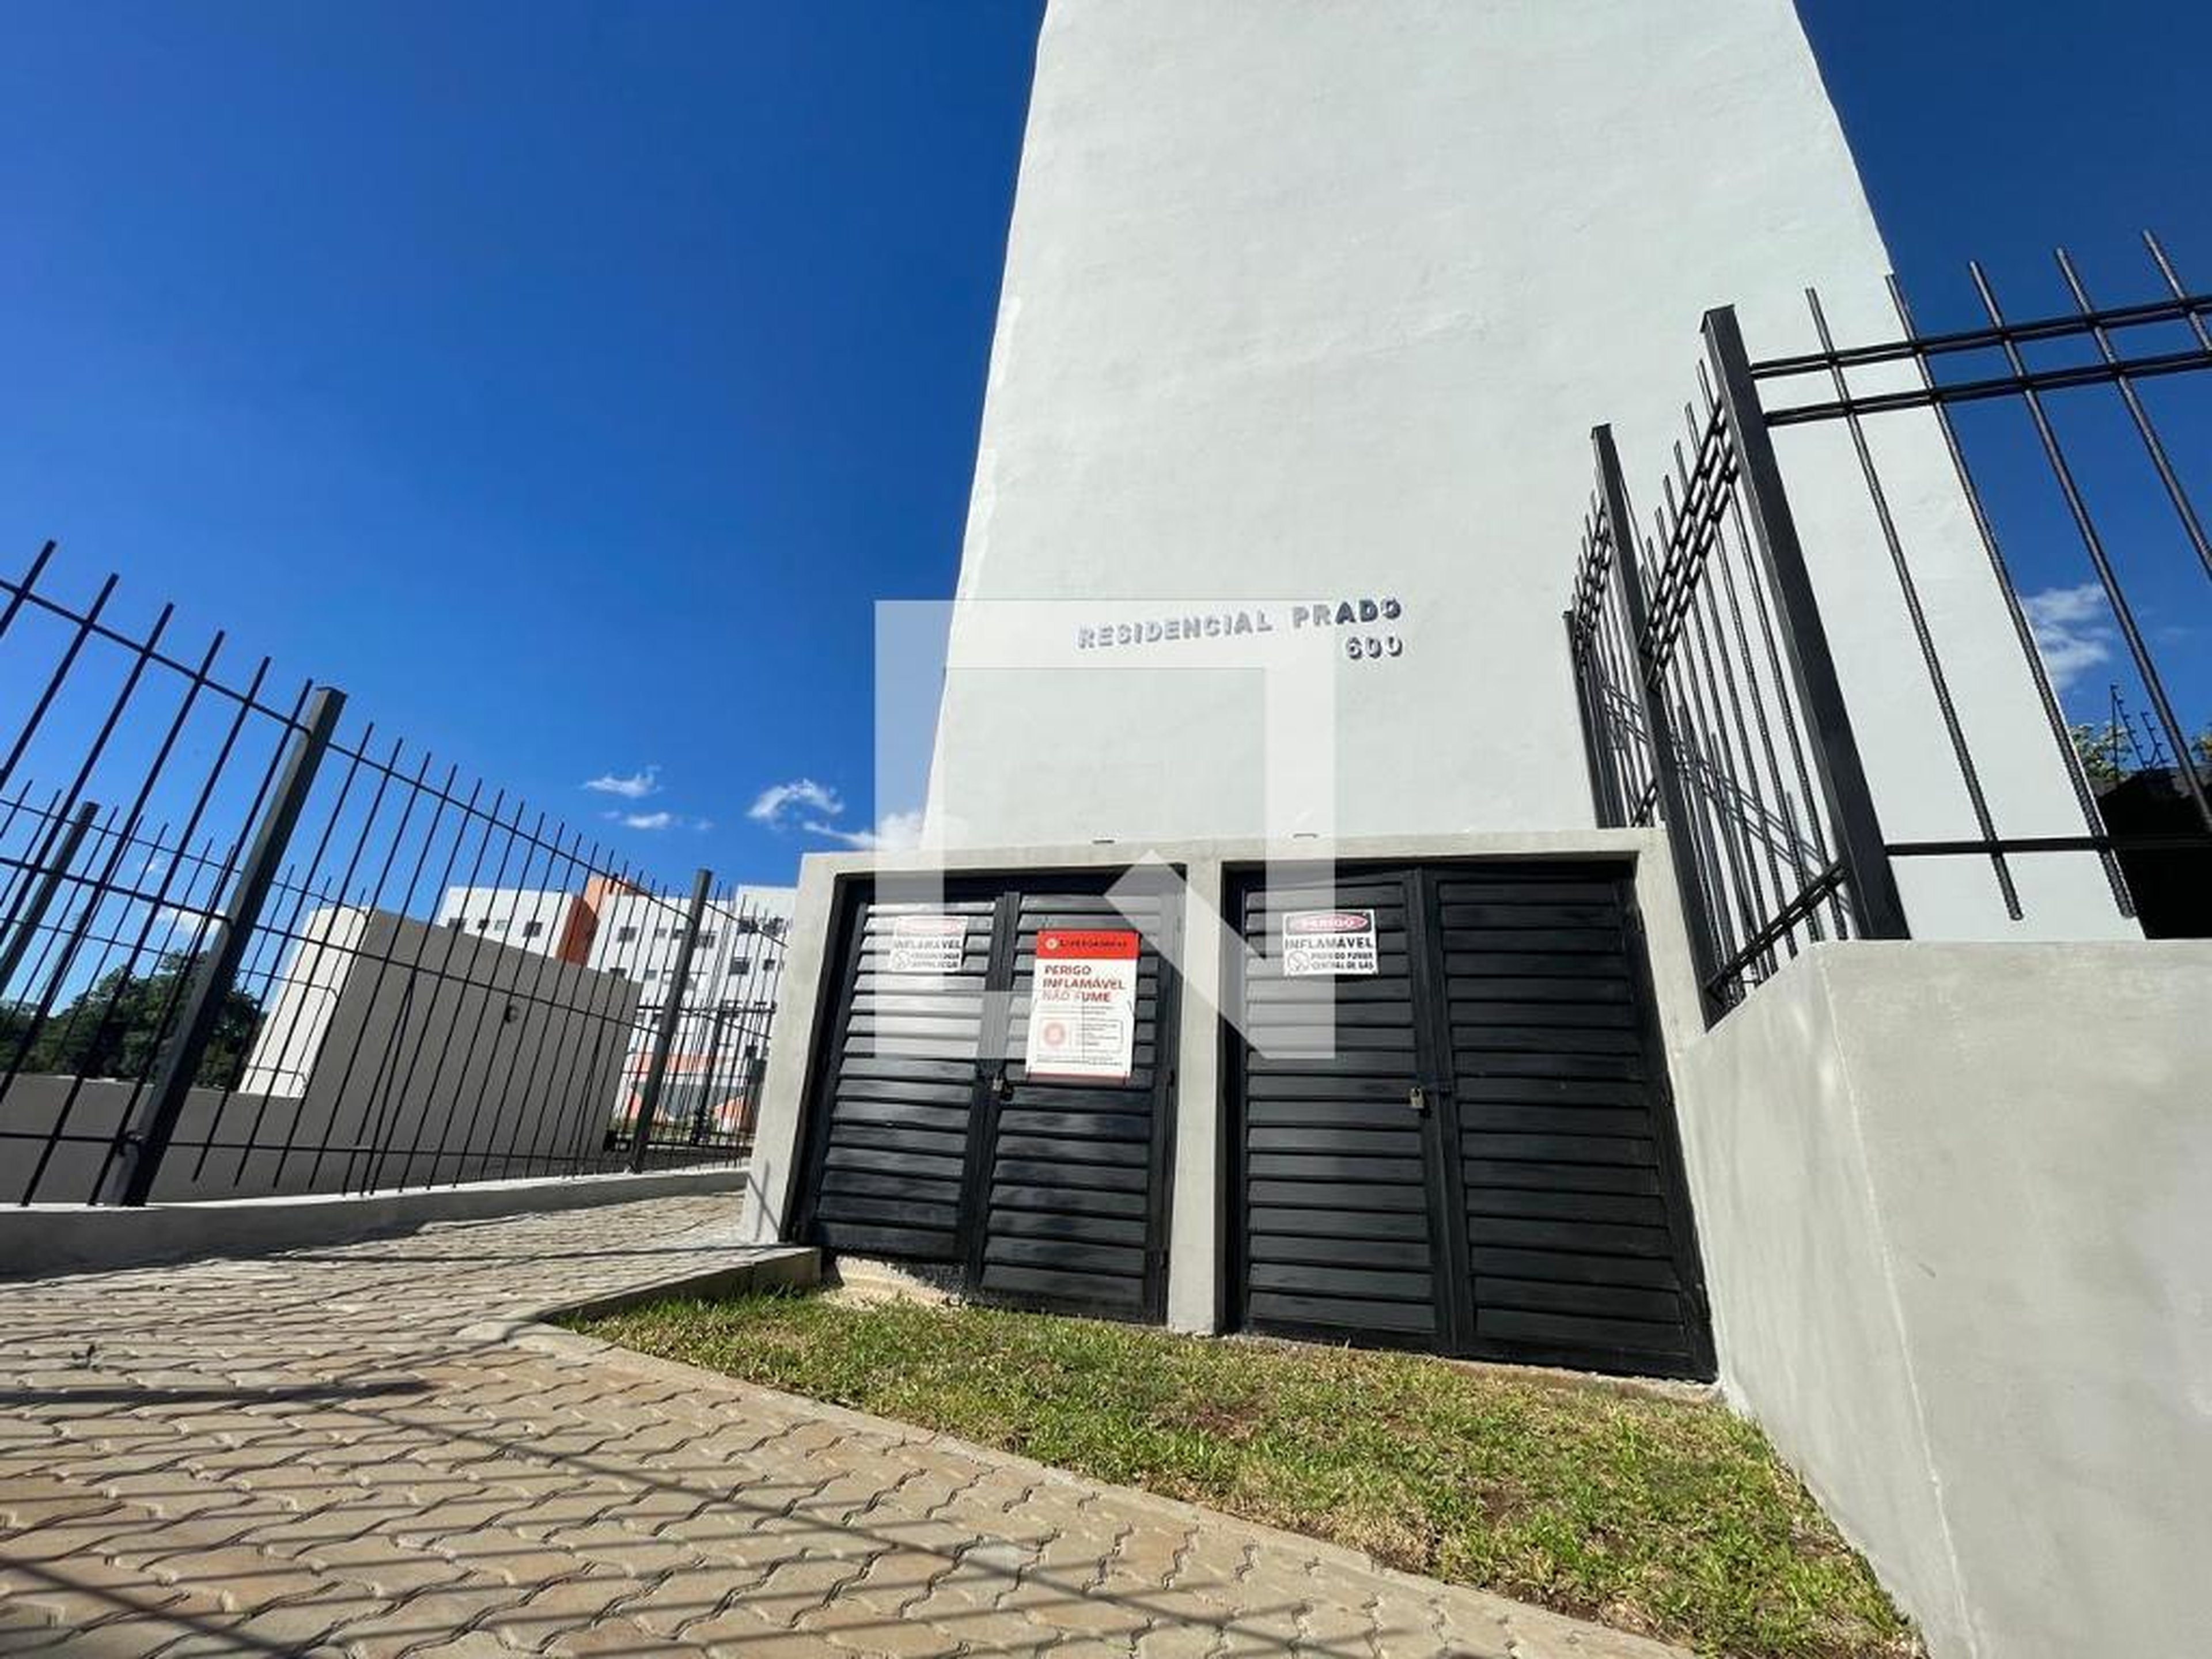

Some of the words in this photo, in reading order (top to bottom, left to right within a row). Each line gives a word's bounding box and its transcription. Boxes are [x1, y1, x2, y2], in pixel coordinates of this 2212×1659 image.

[1078, 610, 1272, 649] RESIDENCIAL
[1293, 598, 1402, 628] PRADO
[1346, 637, 1402, 660] 600
[1044, 965, 1092, 975] PERIGO
[1043, 977, 1126, 990] INFLAMÁVEL
